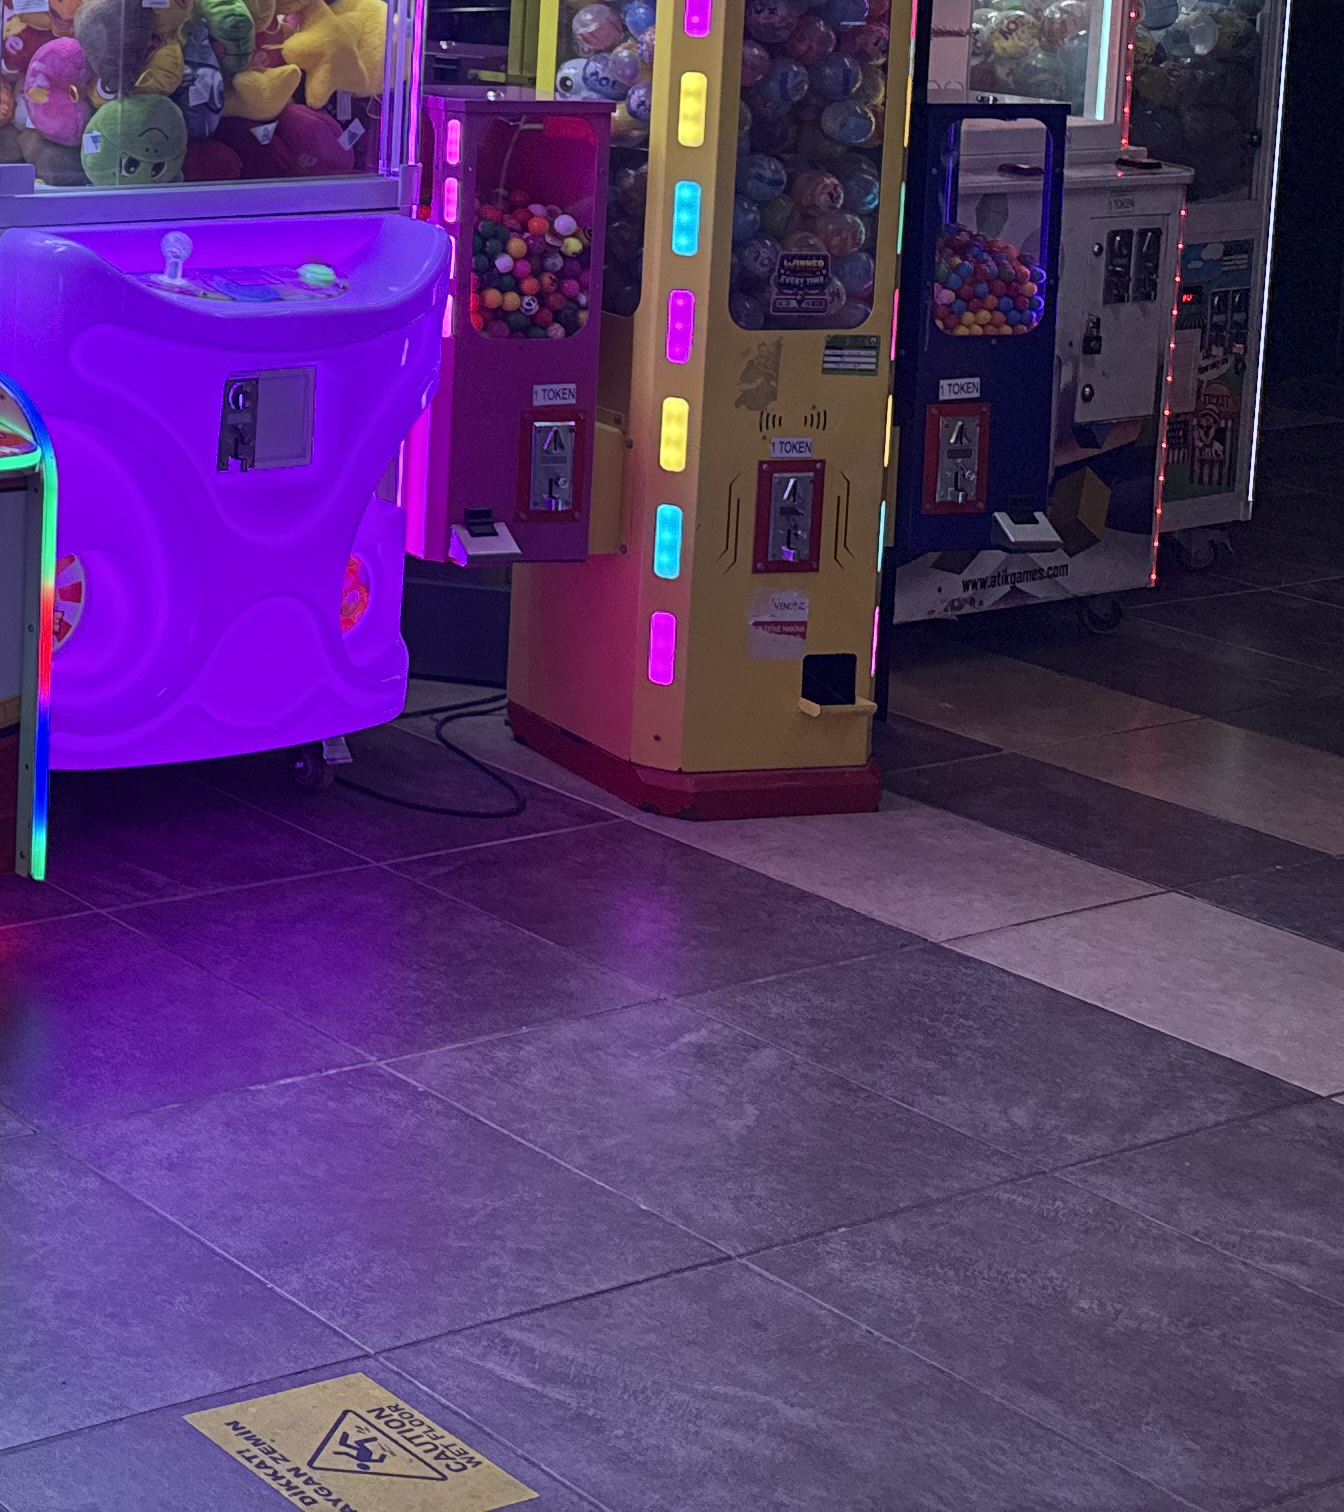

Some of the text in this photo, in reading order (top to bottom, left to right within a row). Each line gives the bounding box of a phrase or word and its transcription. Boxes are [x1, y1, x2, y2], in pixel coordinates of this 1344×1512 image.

[541, 387, 575, 401] TOKEN
[946, 381, 979, 395] TOKEN
[778, 441, 812, 454] TOKEN
[961, 563, 1069, 593] www.atikgames.com
[365, 1406, 469, 1474] CAUTION
[385, 1402, 485, 1469] WET FLOOR
